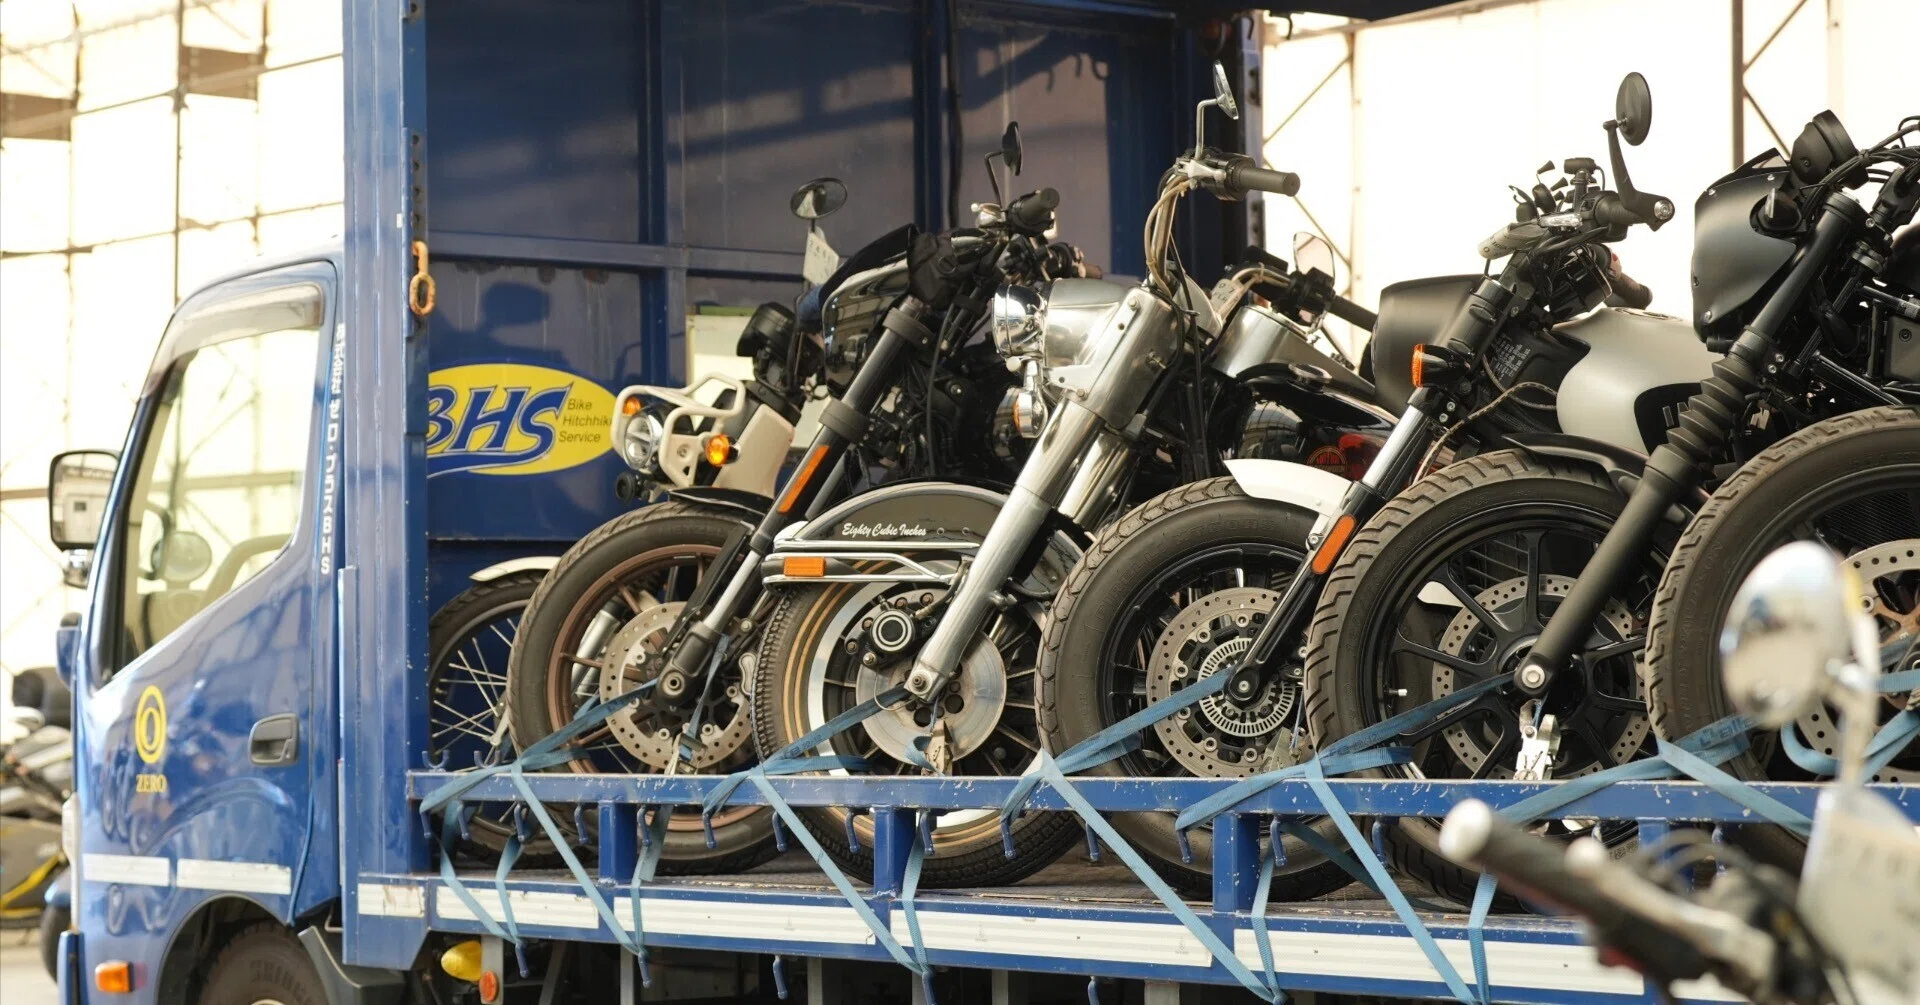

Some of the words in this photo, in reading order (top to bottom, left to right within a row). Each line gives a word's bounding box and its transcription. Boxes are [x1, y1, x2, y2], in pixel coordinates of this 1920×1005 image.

[567, 399, 593, 411] Bike
[427, 381, 574, 453] BHS
[562, 415, 612, 427] Hitchhik
[558, 431, 601, 443] Service
[842, 523, 871, 538] Eighty
[872, 523, 898, 537] Cubic
[899, 523, 927, 537] Inches
[136, 773, 167, 792] ZERO
